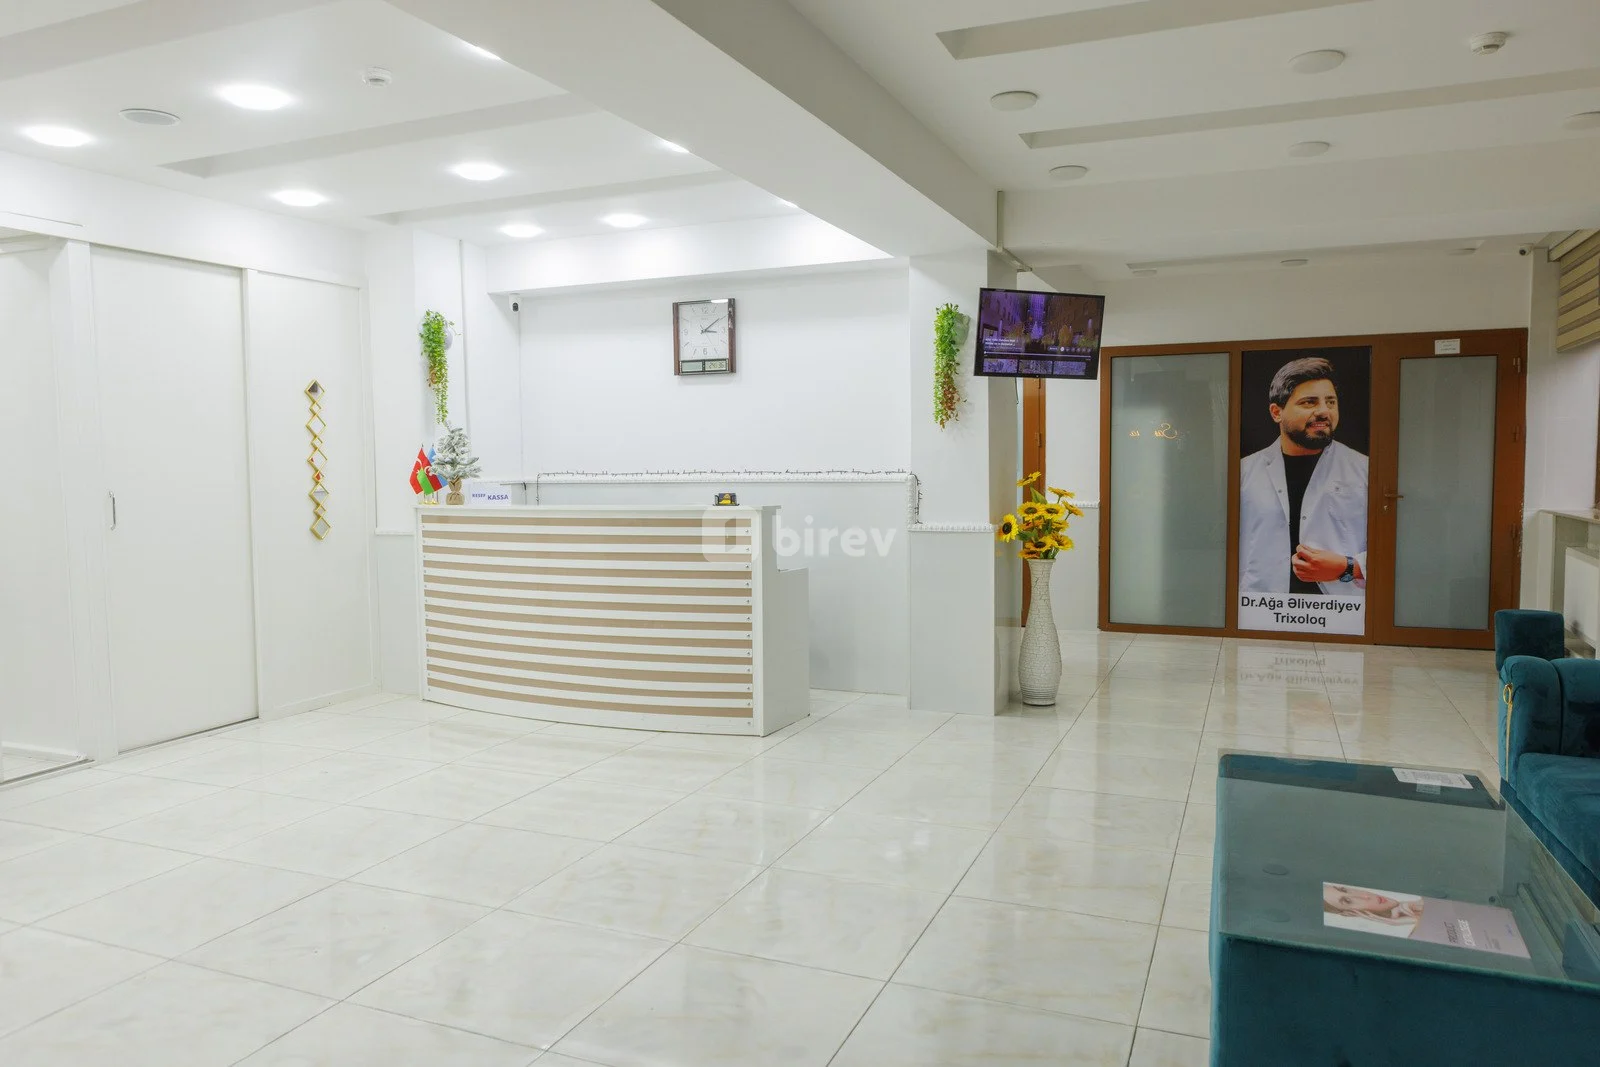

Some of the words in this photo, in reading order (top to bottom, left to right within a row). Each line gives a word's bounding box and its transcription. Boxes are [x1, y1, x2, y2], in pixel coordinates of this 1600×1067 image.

[1241, 596, 1283, 611] Dr.Ağa
[1287, 597, 1362, 614] Əliverdiyev
[1273, 612, 1326, 627] Trixoloq
